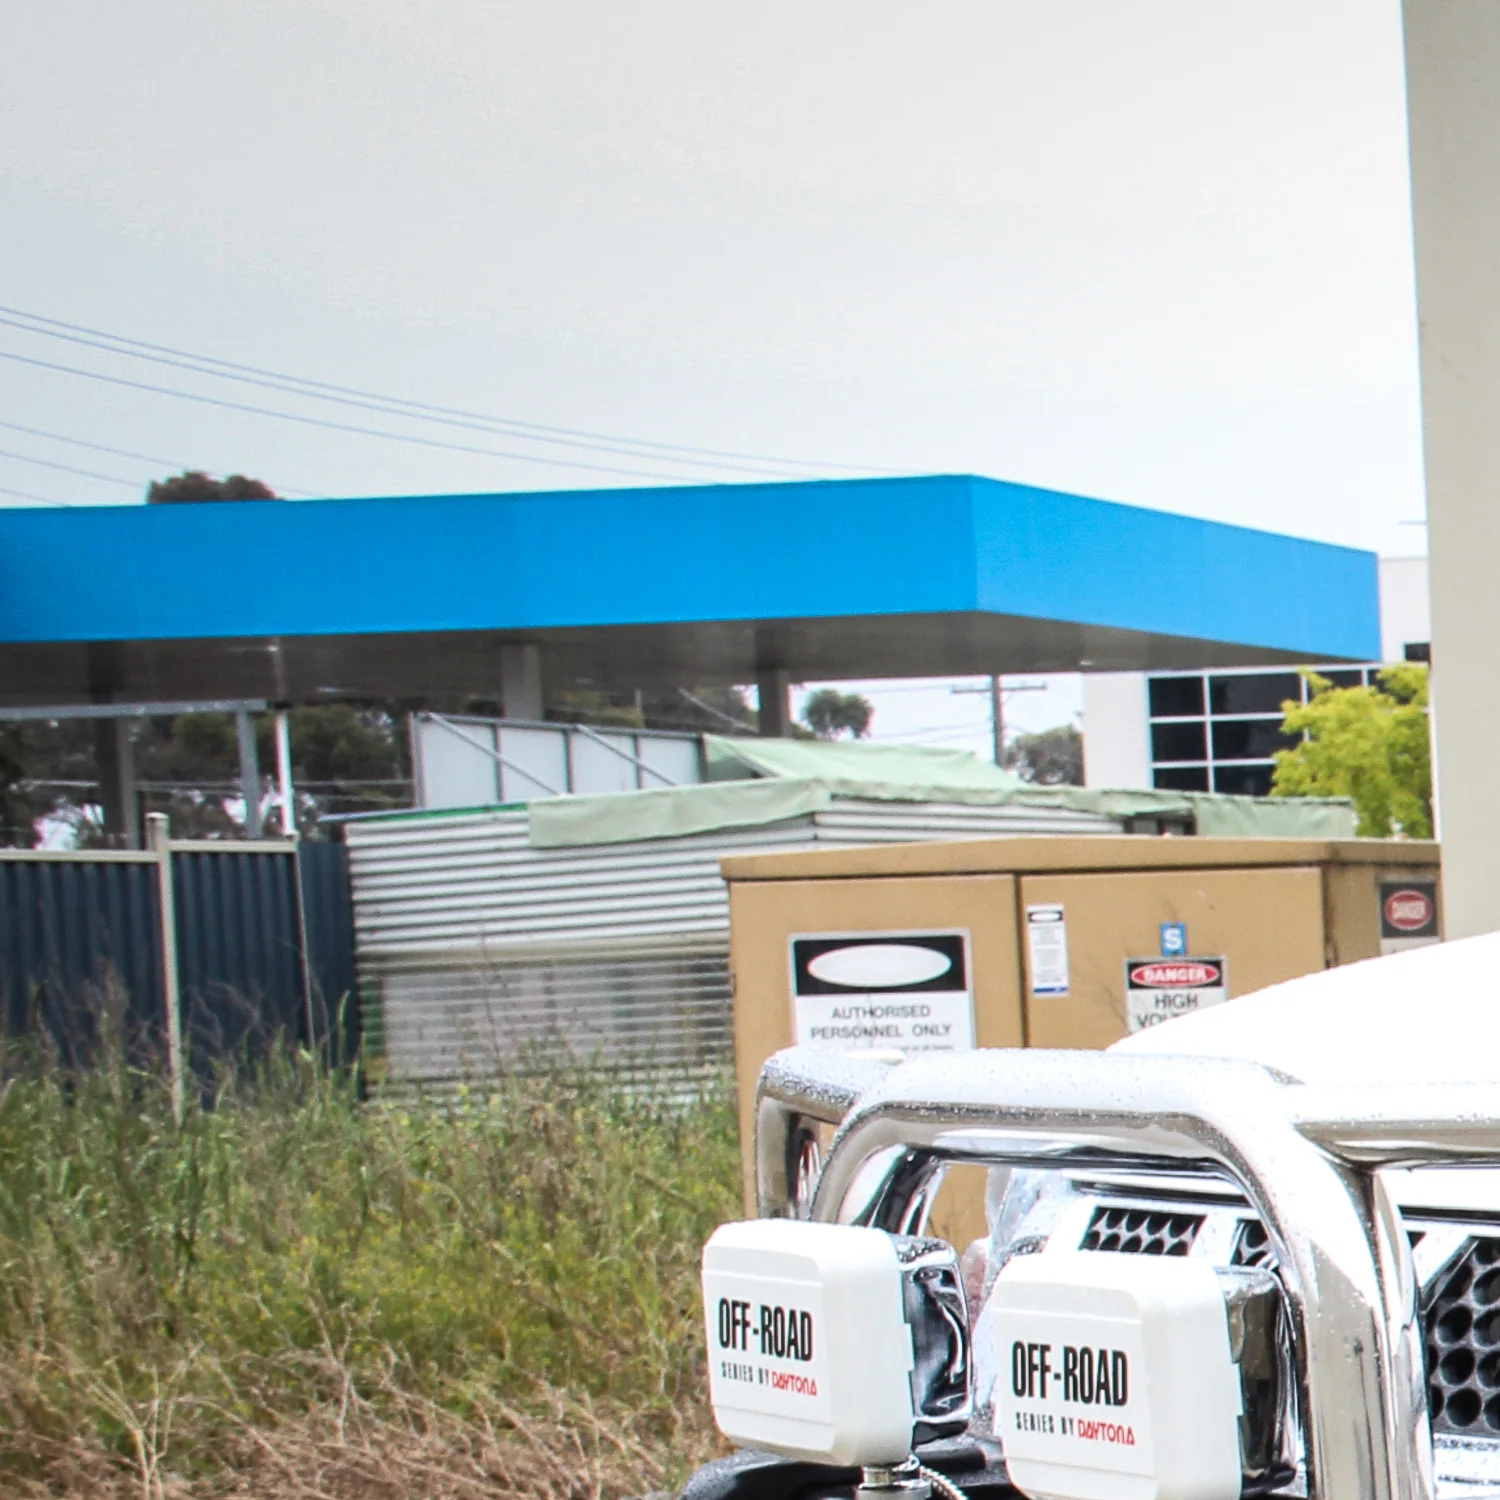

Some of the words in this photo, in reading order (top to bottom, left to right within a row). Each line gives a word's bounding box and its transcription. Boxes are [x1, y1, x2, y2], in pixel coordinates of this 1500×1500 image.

[1163, 928, 1183, 951] S
[1143, 967, 1208, 983] DANGER
[832, 1005, 930, 1020] AUTHORISED
[1155, 993, 1198, 1009] HIGH
[811, 1025, 903, 1040] PERSONNEL
[911, 1023, 952, 1037] ONLY
[718, 1297, 813, 1362] OFF-ROAD
[721, 1361, 754, 1384] SERIES
[758, 1368, 770, 1386] BY
[771, 1370, 818, 1397] DAYTONA
[1012, 1340, 1129, 1407] OFF-ROAD
[1016, 1411, 1055, 1434] SERIES
[1060, 1417, 1075, 1436] BY
[1077, 1418, 1136, 1445] DAYTONA
